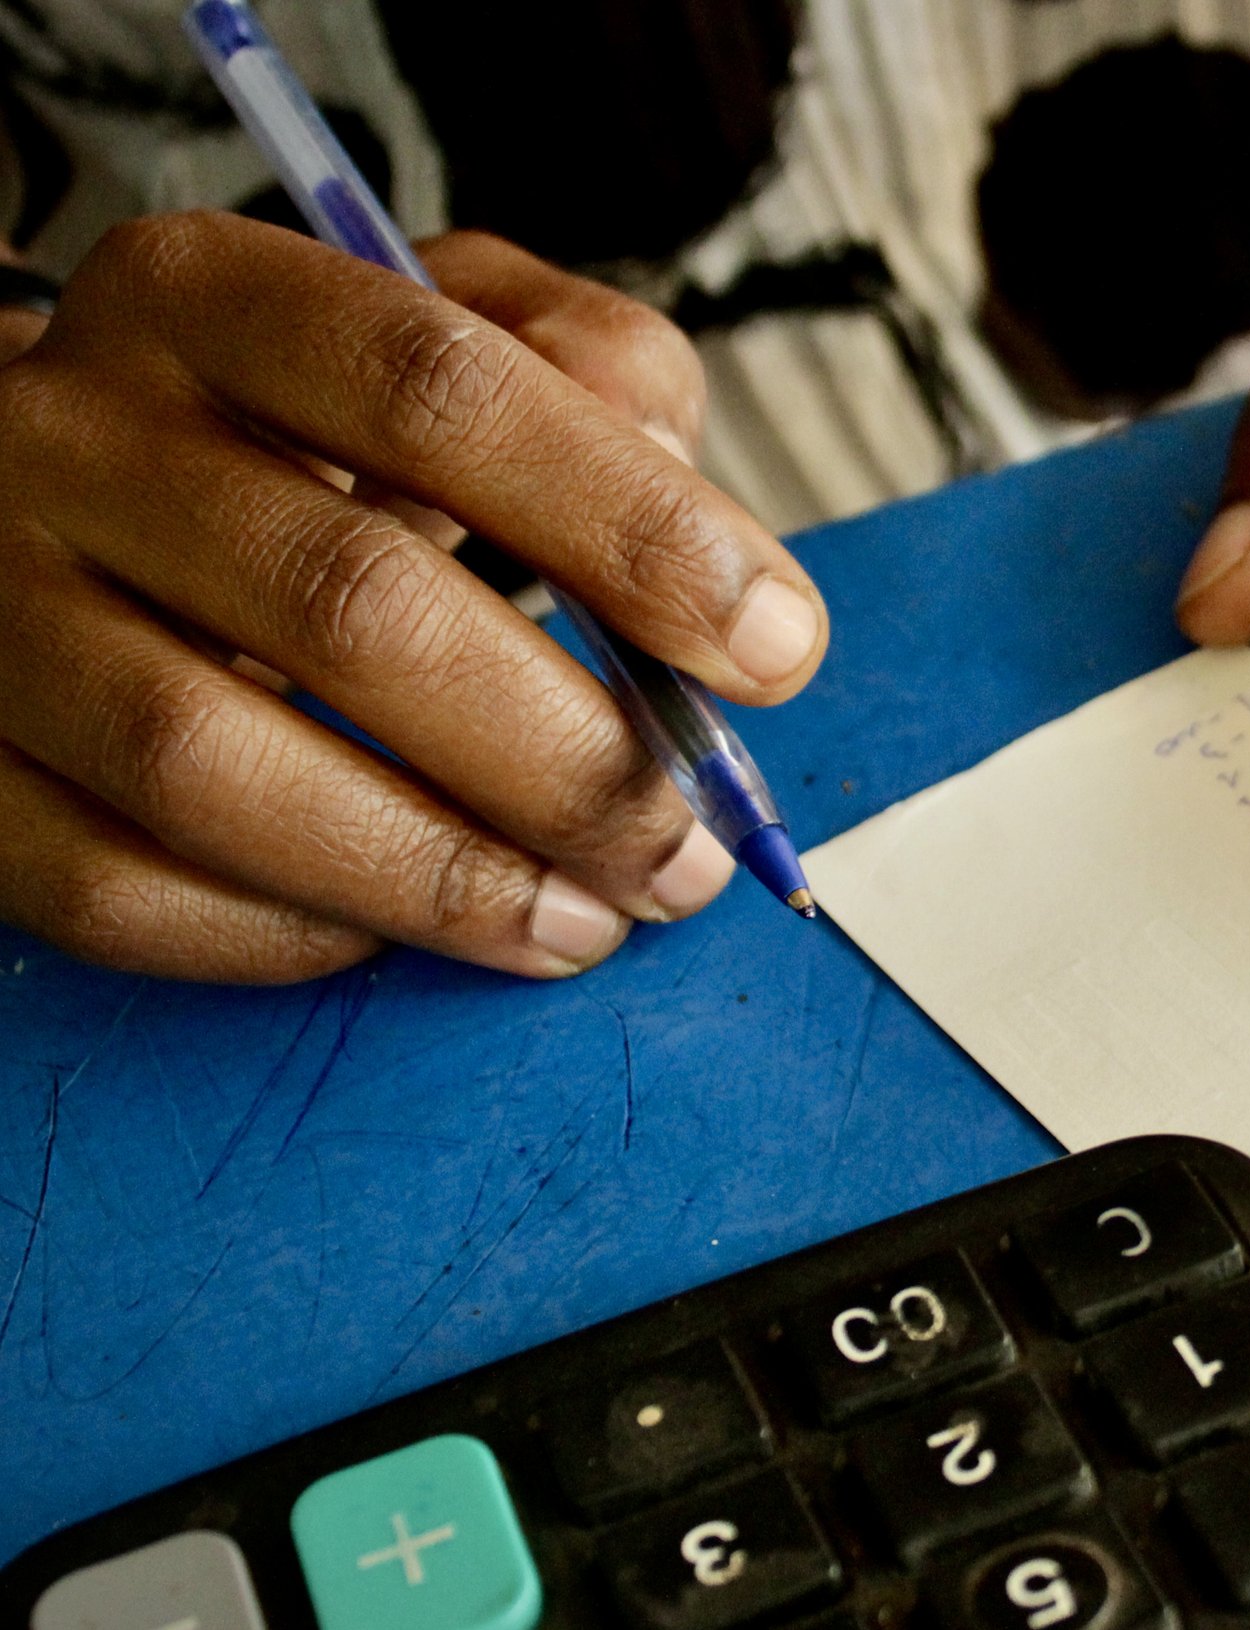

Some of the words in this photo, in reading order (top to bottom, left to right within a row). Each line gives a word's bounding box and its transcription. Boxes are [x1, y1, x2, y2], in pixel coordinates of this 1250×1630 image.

[1172, 1335, 1224, 1388] 1
[926, 1420, 996, 1486] 2
[680, 1519, 747, 1587] 3
[1005, 1557, 1079, 1630] 5
